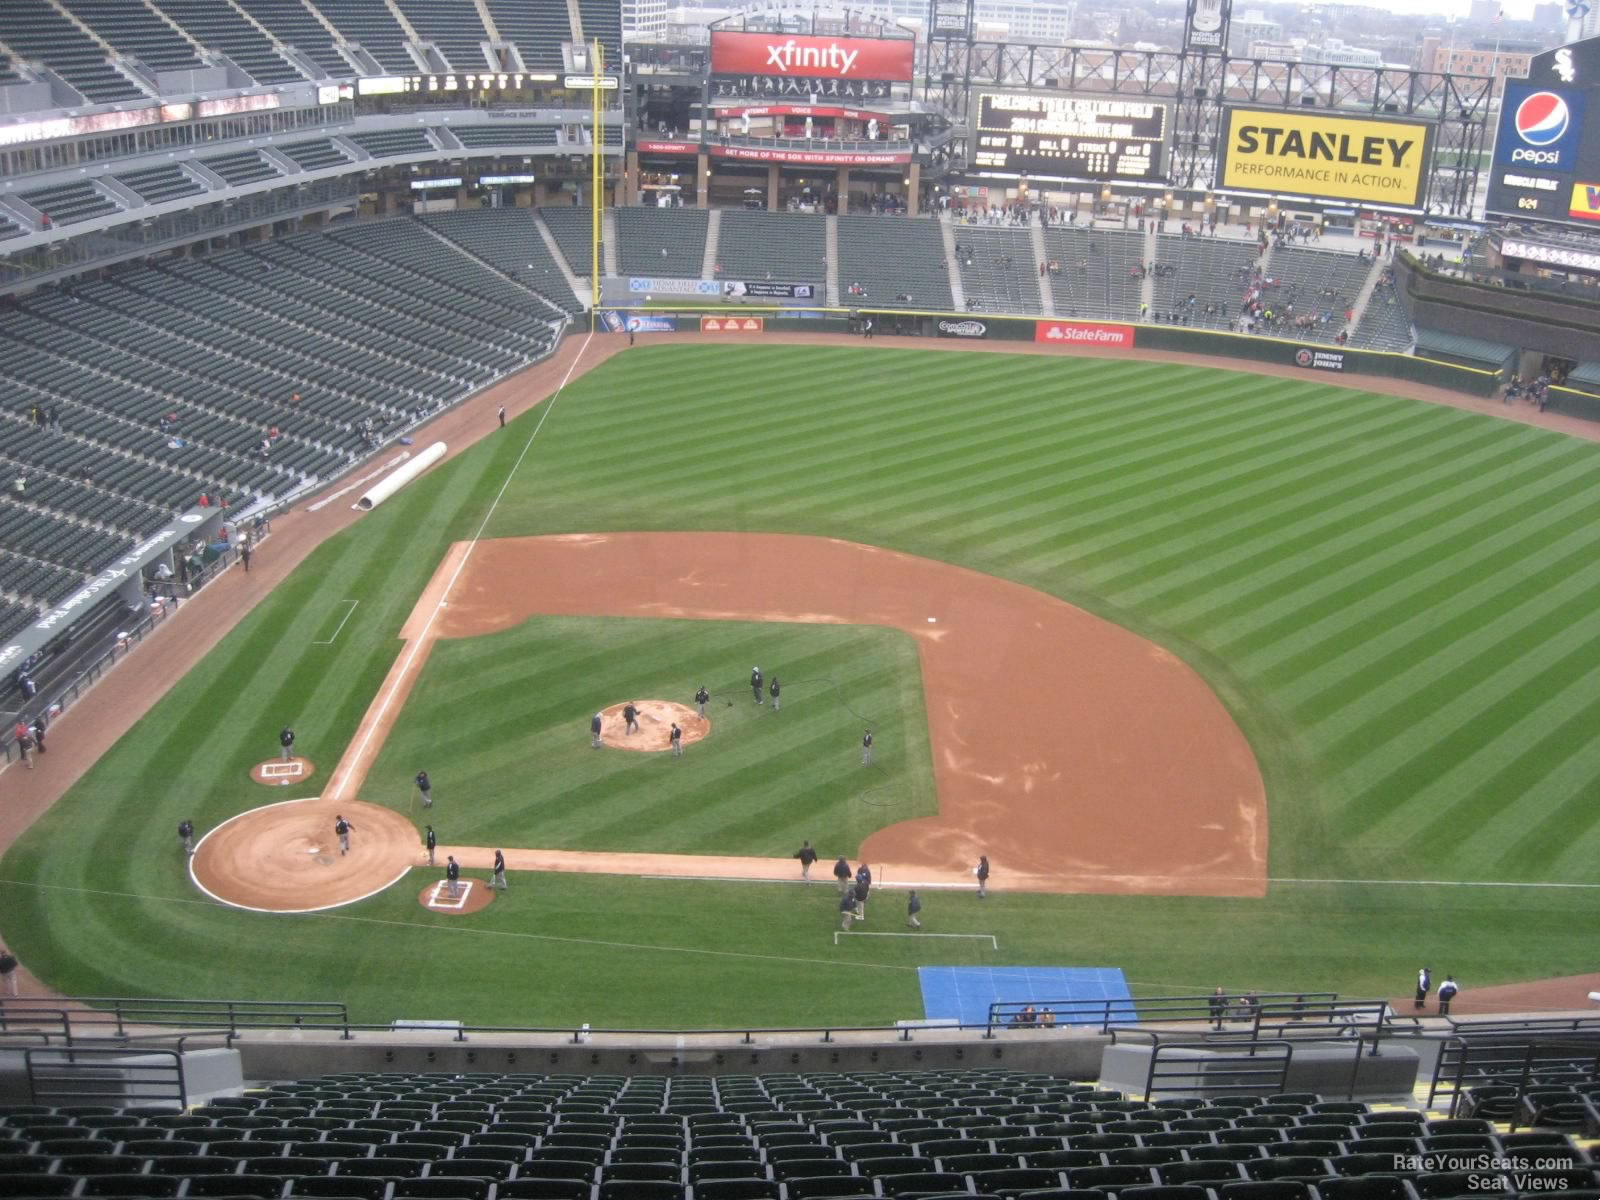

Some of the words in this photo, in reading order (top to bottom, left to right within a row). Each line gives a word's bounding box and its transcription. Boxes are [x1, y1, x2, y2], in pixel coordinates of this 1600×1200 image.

[767, 40, 858, 74] xfinity
[1236, 126, 1414, 168] STANLEY
[1512, 148, 1560, 164] pepsi
[1234, 162, 1330, 182] PERFORMANCE
[1334, 172, 1348, 184] IN
[1352, 174, 1402, 189] ACTION
[1313, 360, 1342, 368] JOHN'S
[1314, 352, 1344, 361] JIMMY
